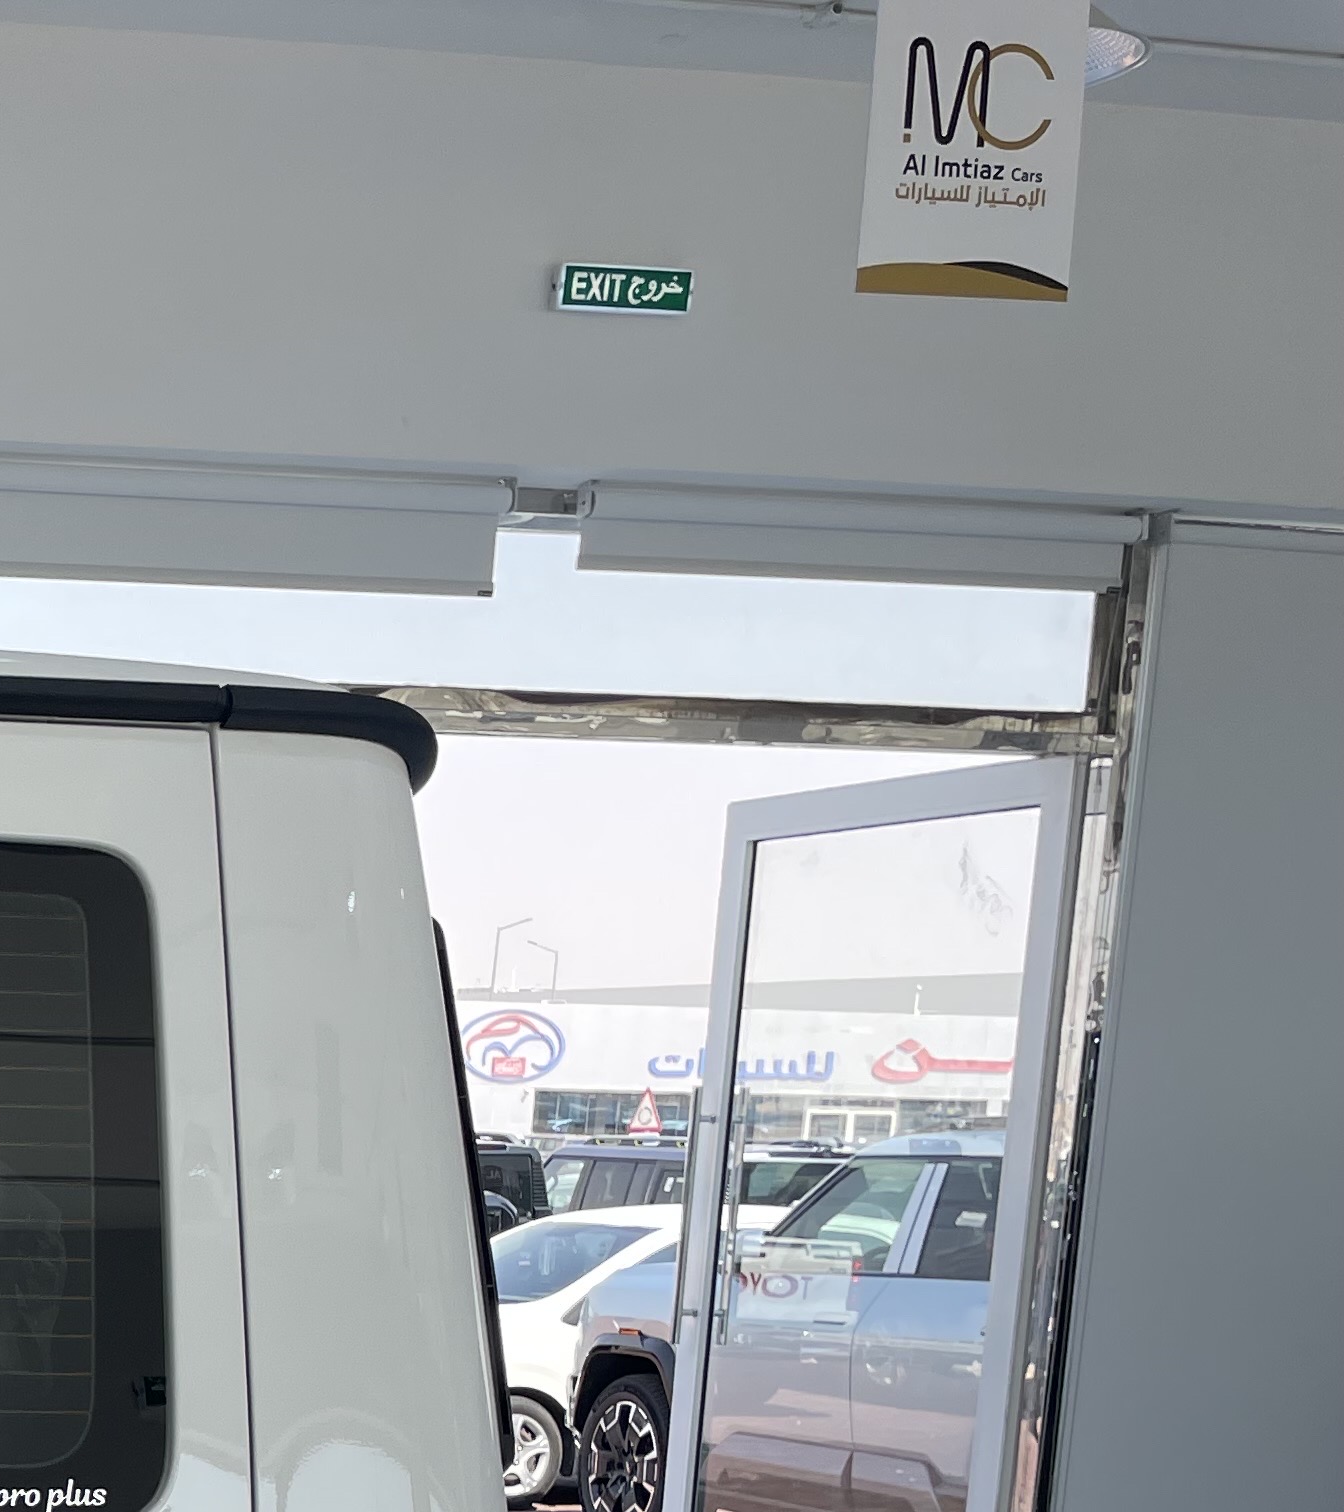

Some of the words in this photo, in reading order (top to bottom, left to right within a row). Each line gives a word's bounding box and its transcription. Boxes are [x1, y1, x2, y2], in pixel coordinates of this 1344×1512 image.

[903, 153, 926, 176] Al
[934, 155, 1004, 180] Imtiaz
[1011, 167, 1043, 183] Cars
[895, 181, 971, 206] للسيارات
[571, 271, 626, 302] EXIT
[627, 275, 684, 305] خروج
